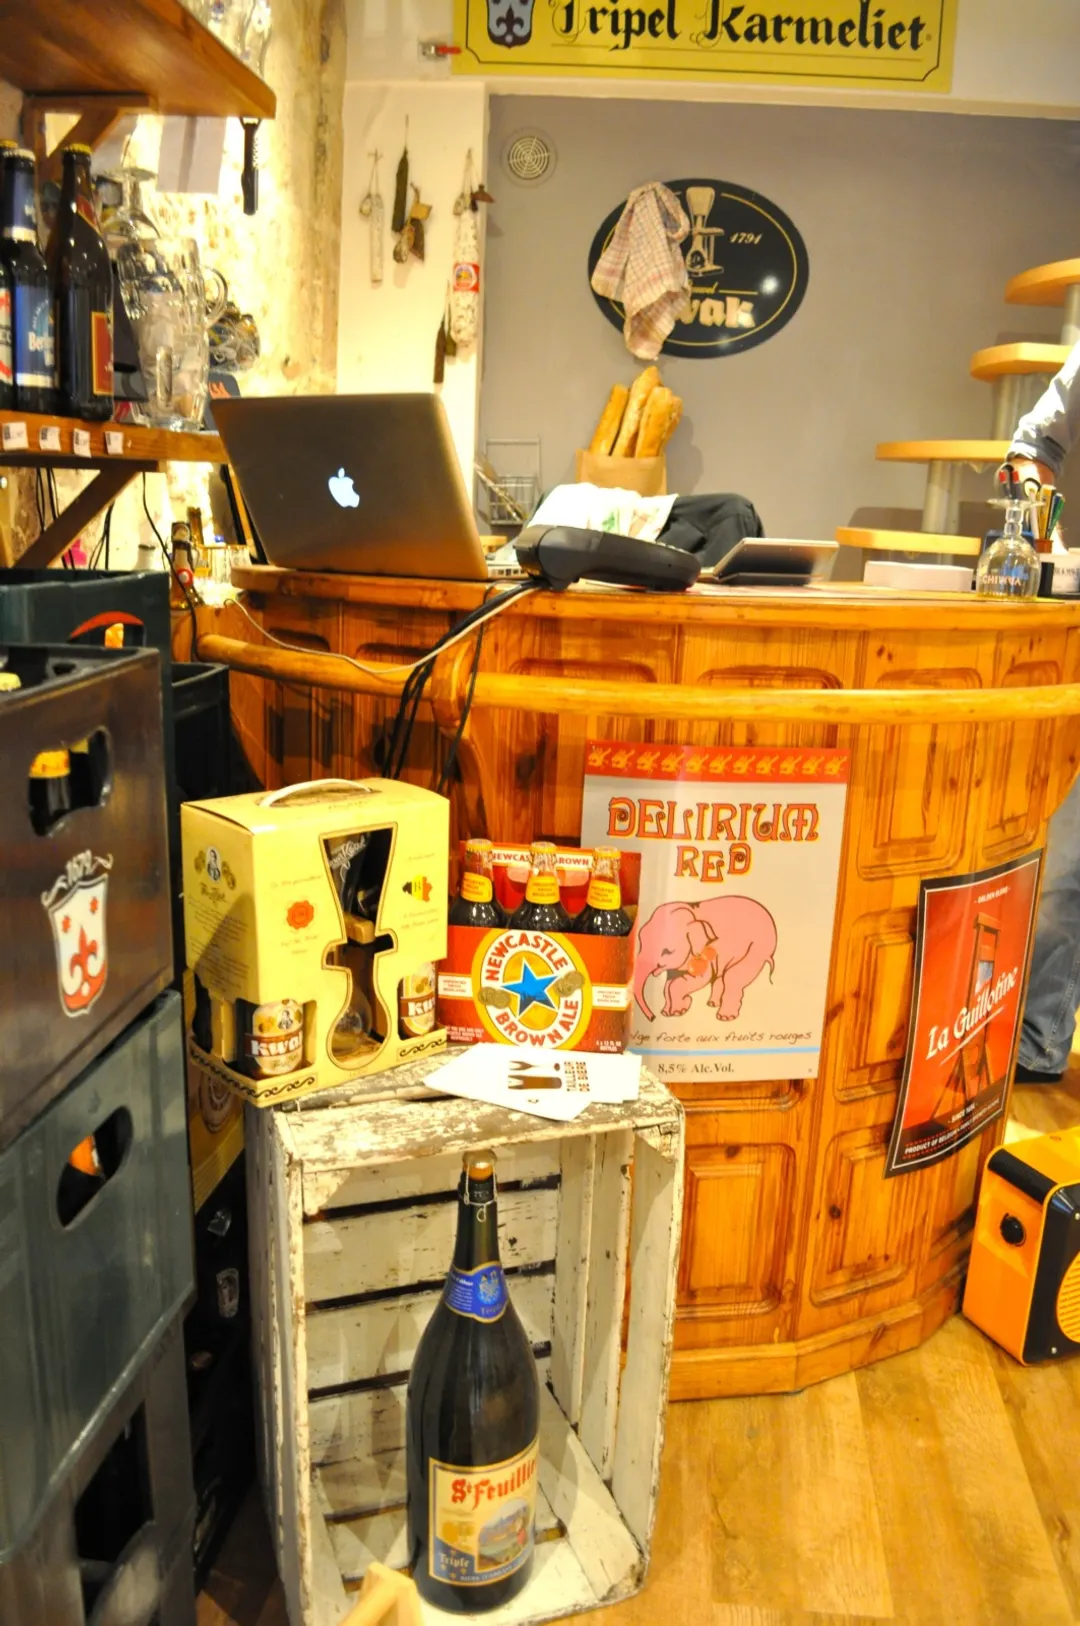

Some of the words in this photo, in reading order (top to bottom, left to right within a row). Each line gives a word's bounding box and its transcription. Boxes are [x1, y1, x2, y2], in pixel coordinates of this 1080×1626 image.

[552, 0, 682, 51] Tripel
[697, 0, 925, 51] Karmeliet
[675, 296, 756, 328] wak
[606, 796, 819, 842] DELIRIUM
[556, 856, 589, 866] ROWN
[674, 842, 752, 883] RED
[485, 932, 569, 982] NEWCASTLE
[495, 1011, 564, 1047] BROWN
[558, 1000, 579, 1032] ALE
[926, 1025, 949, 1061] La
[953, 966, 1019, 1039] Guillotine
[656, 1031, 691, 1043] forte
[695, 1035, 720, 1043] aux
[724, 1031, 765, 1043] fruits
[769, 1031, 812, 1045] rouges
[658, 1063, 687, 1075] 8,5%
[904, 1141, 931, 1155] PRODUCT
[440, 1552, 469, 1567] Triple
